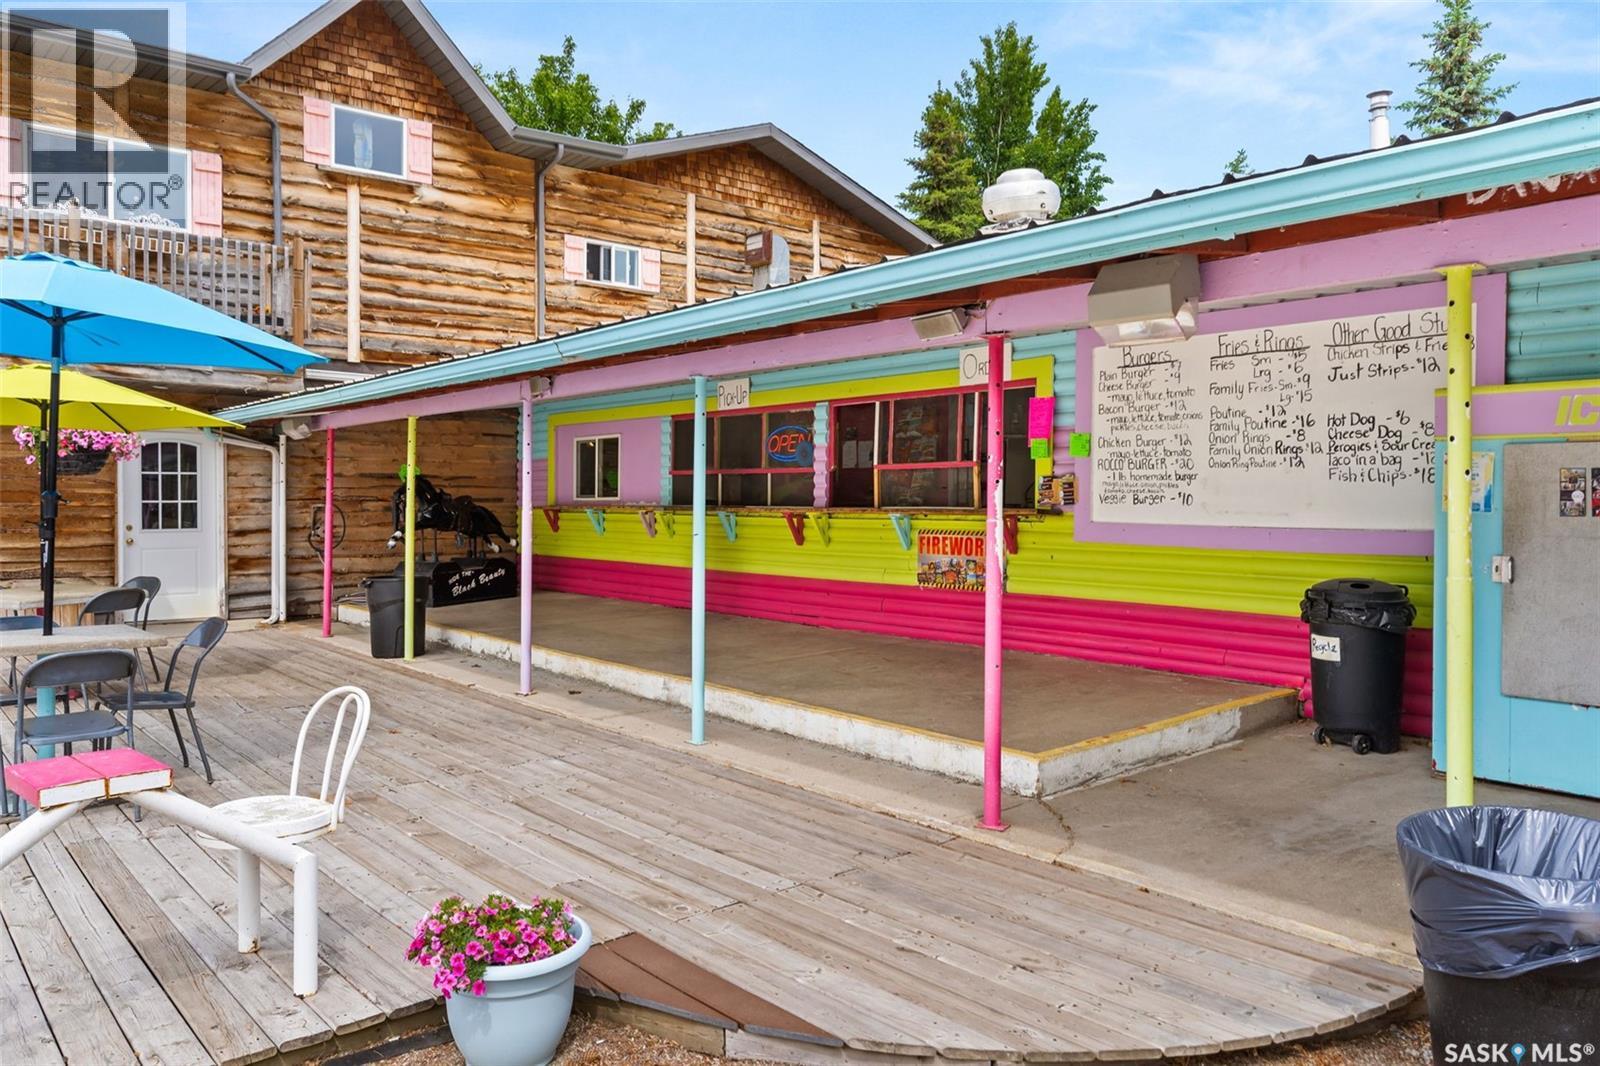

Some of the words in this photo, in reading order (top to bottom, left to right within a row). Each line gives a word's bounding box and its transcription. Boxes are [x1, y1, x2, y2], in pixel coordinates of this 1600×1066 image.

[1332, 322, 1369, 345] Other
[1374, 313, 1411, 341] Good
[1420, 312, 1448, 334] Stu
[1218, 333, 1250, 356] Fries
[1263, 329, 1304, 352] Rings
[1327, 347, 1369, 361] Chicken
[1373, 342, 1411, 359] Strips
[1425, 337, 1448, 352] Frie
[1122, 345, 1172, 369] Burgers
[1210, 360, 1235, 371] Fries
[1251, 354, 1272, 366] Sm
[1099, 370, 1118, 382] Plain
[1121, 368, 1155, 382] Burger
[1253, 367, 1272, 383] Lrg
[1328, 362, 1363, 382] Just
[1098, 382, 1123, 392] Cheese
[1126, 380, 1153, 393] Burger
[1166, 386, 1196, 398] tomato
[1209, 380, 1245, 400] Family
[1098, 403, 1124, 415] Bacon
[1128, 401, 1160, 414] Burger
[1210, 405, 1247, 419] Poutine
[1209, 420, 1240, 435] Family
[1244, 416, 1288, 430] Poutine
[1327, 413, 1346, 427] Hot
[1350, 412, 1376, 431] Dog
[1098, 436, 1131, 448] Chicken
[1135, 433, 1166, 449] Burger
[1208, 432, 1237, 444] Onion
[1242, 430, 1271, 447] Rings
[1328, 427, 1369, 440] Cheese
[1377, 425, 1402, 443] Dog
[1209, 444, 1241, 460] Family
[1243, 443, 1273, 455] Onion
[1275, 440, 1304, 459] Rings
[1328, 440, 1372, 457] Perogies
[1381, 439, 1411, 451] Sour
[1412, 437, 1435, 450] Crea
[1098, 458, 1124, 471] ROCCO
[1127, 458, 1167, 470] BURGER
[1208, 457, 1231, 469] Onion
[1231, 457, 1249, 472] Ring
[1249, 457, 1277, 468] Poutine
[1326, 452, 1351, 467] Taco
[1355, 454, 1367, 465] in
[1369, 454, 1376, 465] a
[1380, 452, 1403, 472] bag
[1130, 470, 1172, 481] homemade
[1174, 470, 1198, 486] burger
[1328, 467, 1357, 482] Fish
[1367, 468, 1406, 486] Chips
[1099, 494, 1127, 505] Veggie
[1132, 493, 1166, 505] Burger
[918, 534, 985, 557] FIREWOR
[452, 578, 477, 597] Black
[478, 567, 506, 585] Beauty
